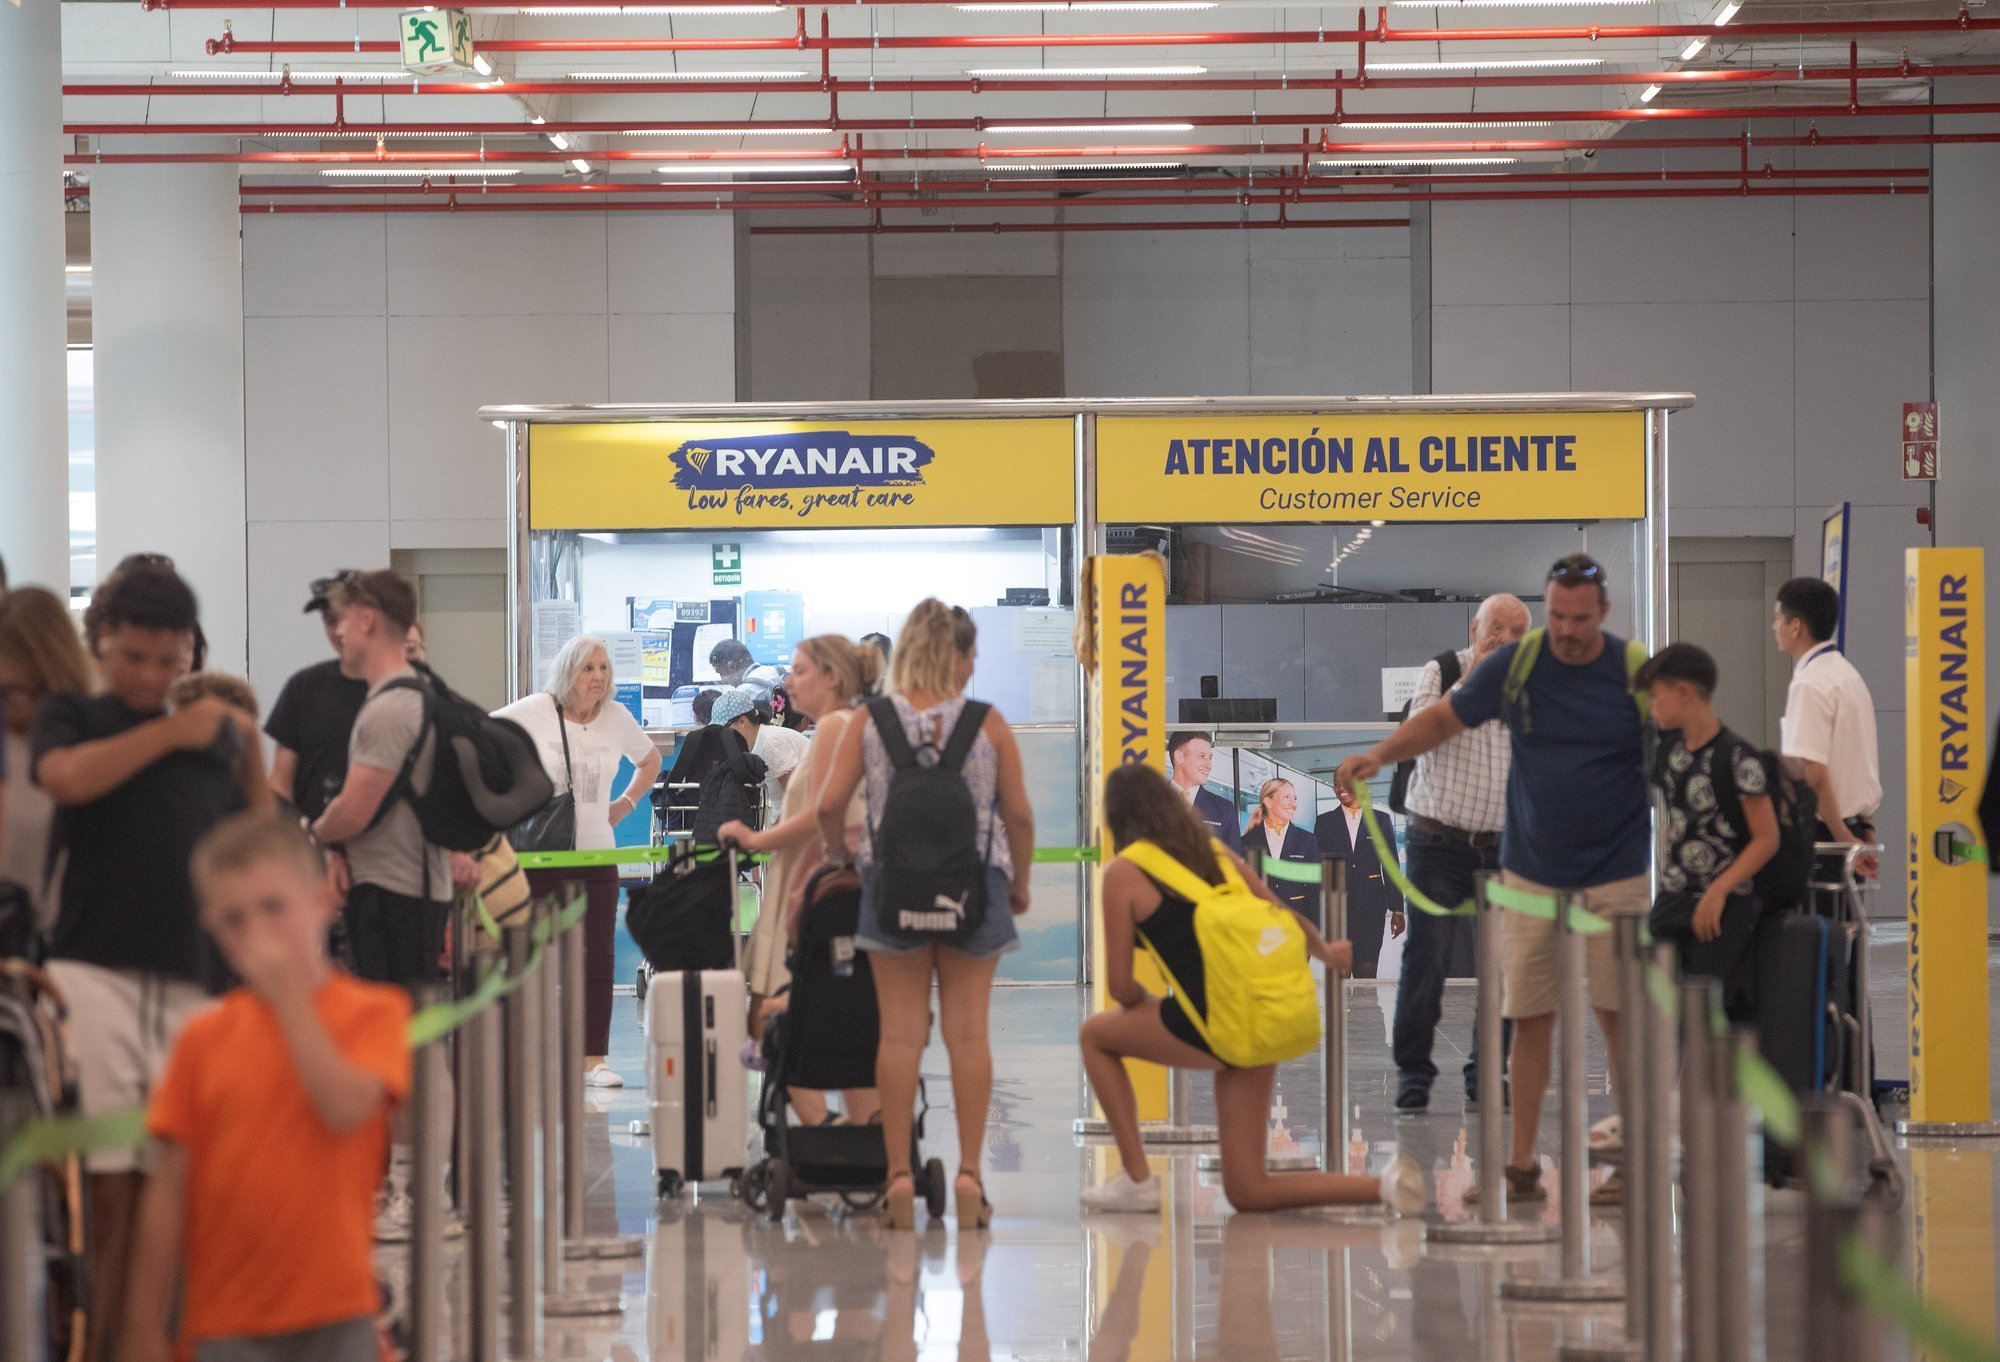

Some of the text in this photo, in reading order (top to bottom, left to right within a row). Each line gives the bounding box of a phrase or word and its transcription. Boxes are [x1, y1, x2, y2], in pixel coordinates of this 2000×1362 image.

[717, 447, 916, 475] RYANAIR
[1164, 427, 1577, 475] ATENCIÓN AL CLIENTE
[688, 484, 915, 517] Low fares, great care
[1259, 486, 1481, 510] Customer Service
[681, 608, 704, 616] 89392
[1121, 582, 1149, 768] RYANAIR
[1939, 574, 1969, 771] RYANAIR
[900, 911, 956, 929] PUMA
